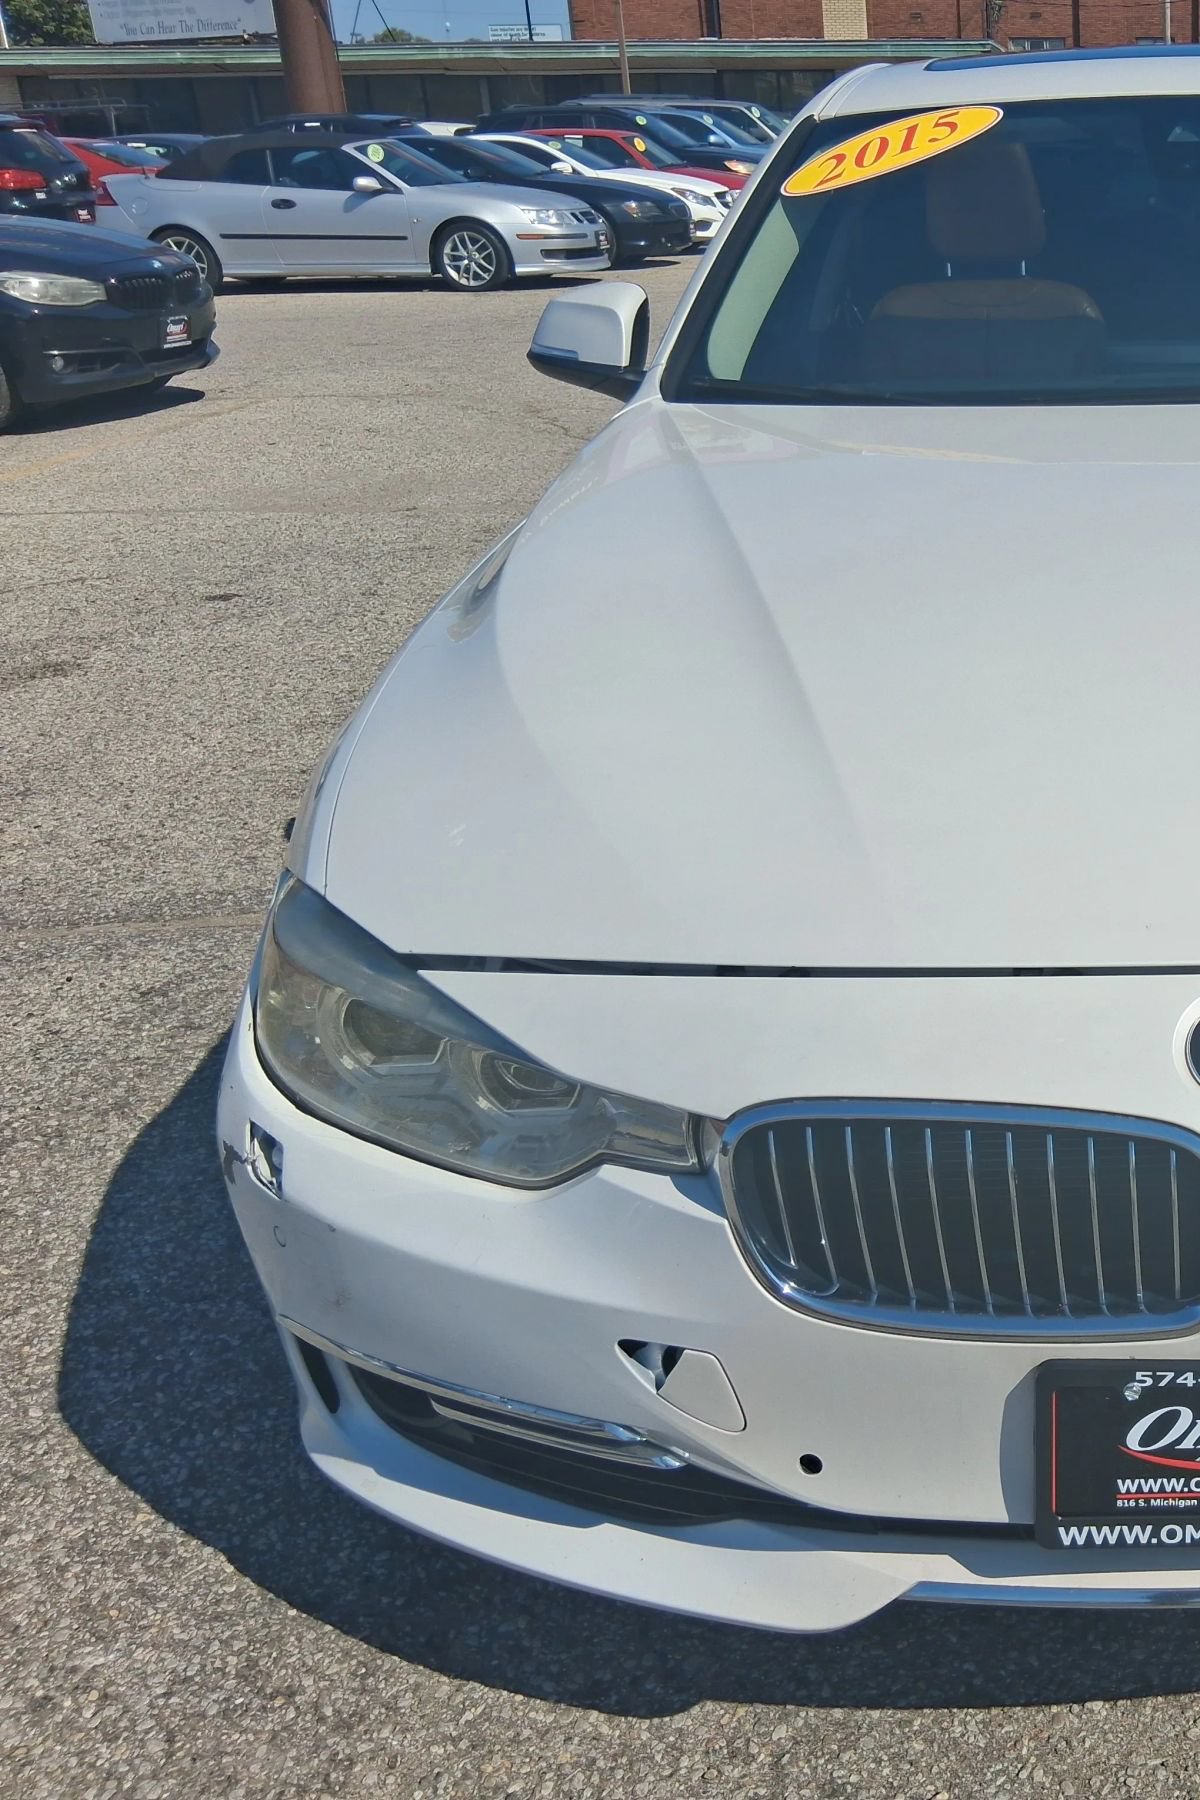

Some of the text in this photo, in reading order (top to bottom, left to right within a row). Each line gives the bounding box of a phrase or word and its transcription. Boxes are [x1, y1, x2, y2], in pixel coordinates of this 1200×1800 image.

[140, 23, 155, 35] Can
[157, 21, 176, 34] Hear
[178, 19, 194, 33] The
[813, 110, 960, 189] 2015
[1116, 1499, 1136, 1507] 816
[1138, 1498, 1148, 1507] S.
[1150, 1498, 1198, 1508] Michigan
